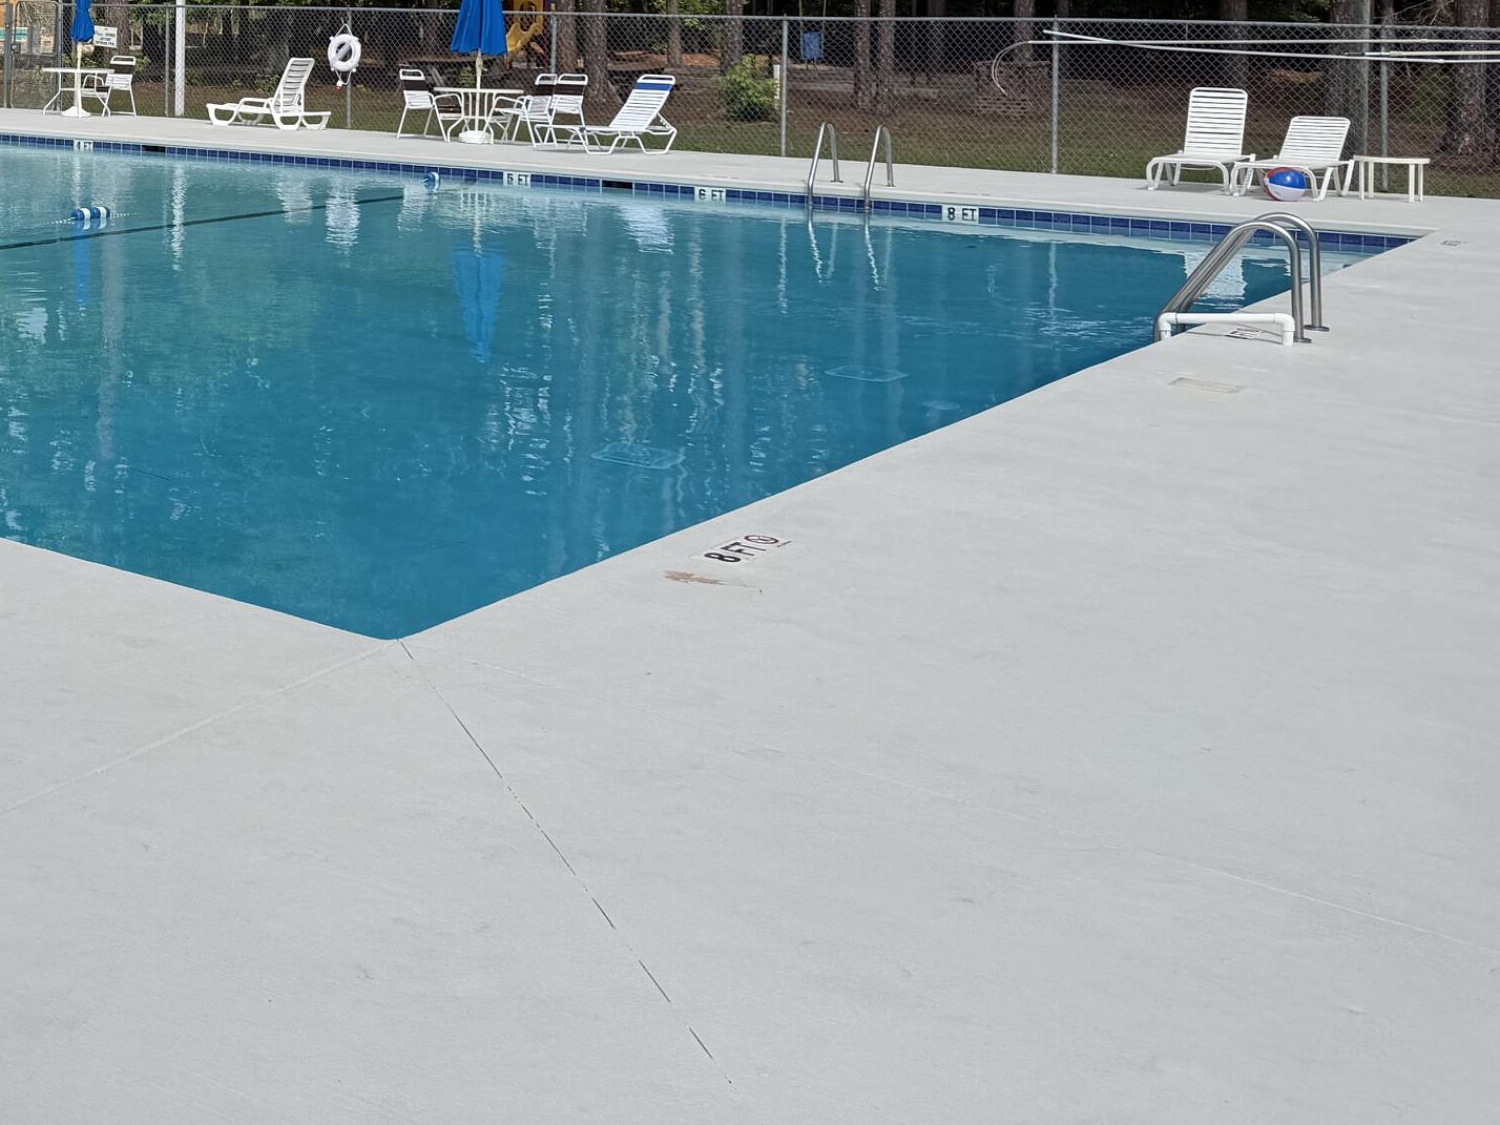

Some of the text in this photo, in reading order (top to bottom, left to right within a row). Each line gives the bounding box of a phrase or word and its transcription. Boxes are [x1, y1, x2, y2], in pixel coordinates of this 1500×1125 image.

[699, 188, 725, 202] 6 FT
[947, 207, 956, 221] 8
[720, 541, 766, 556] FT
[704, 552, 741, 563] 8
